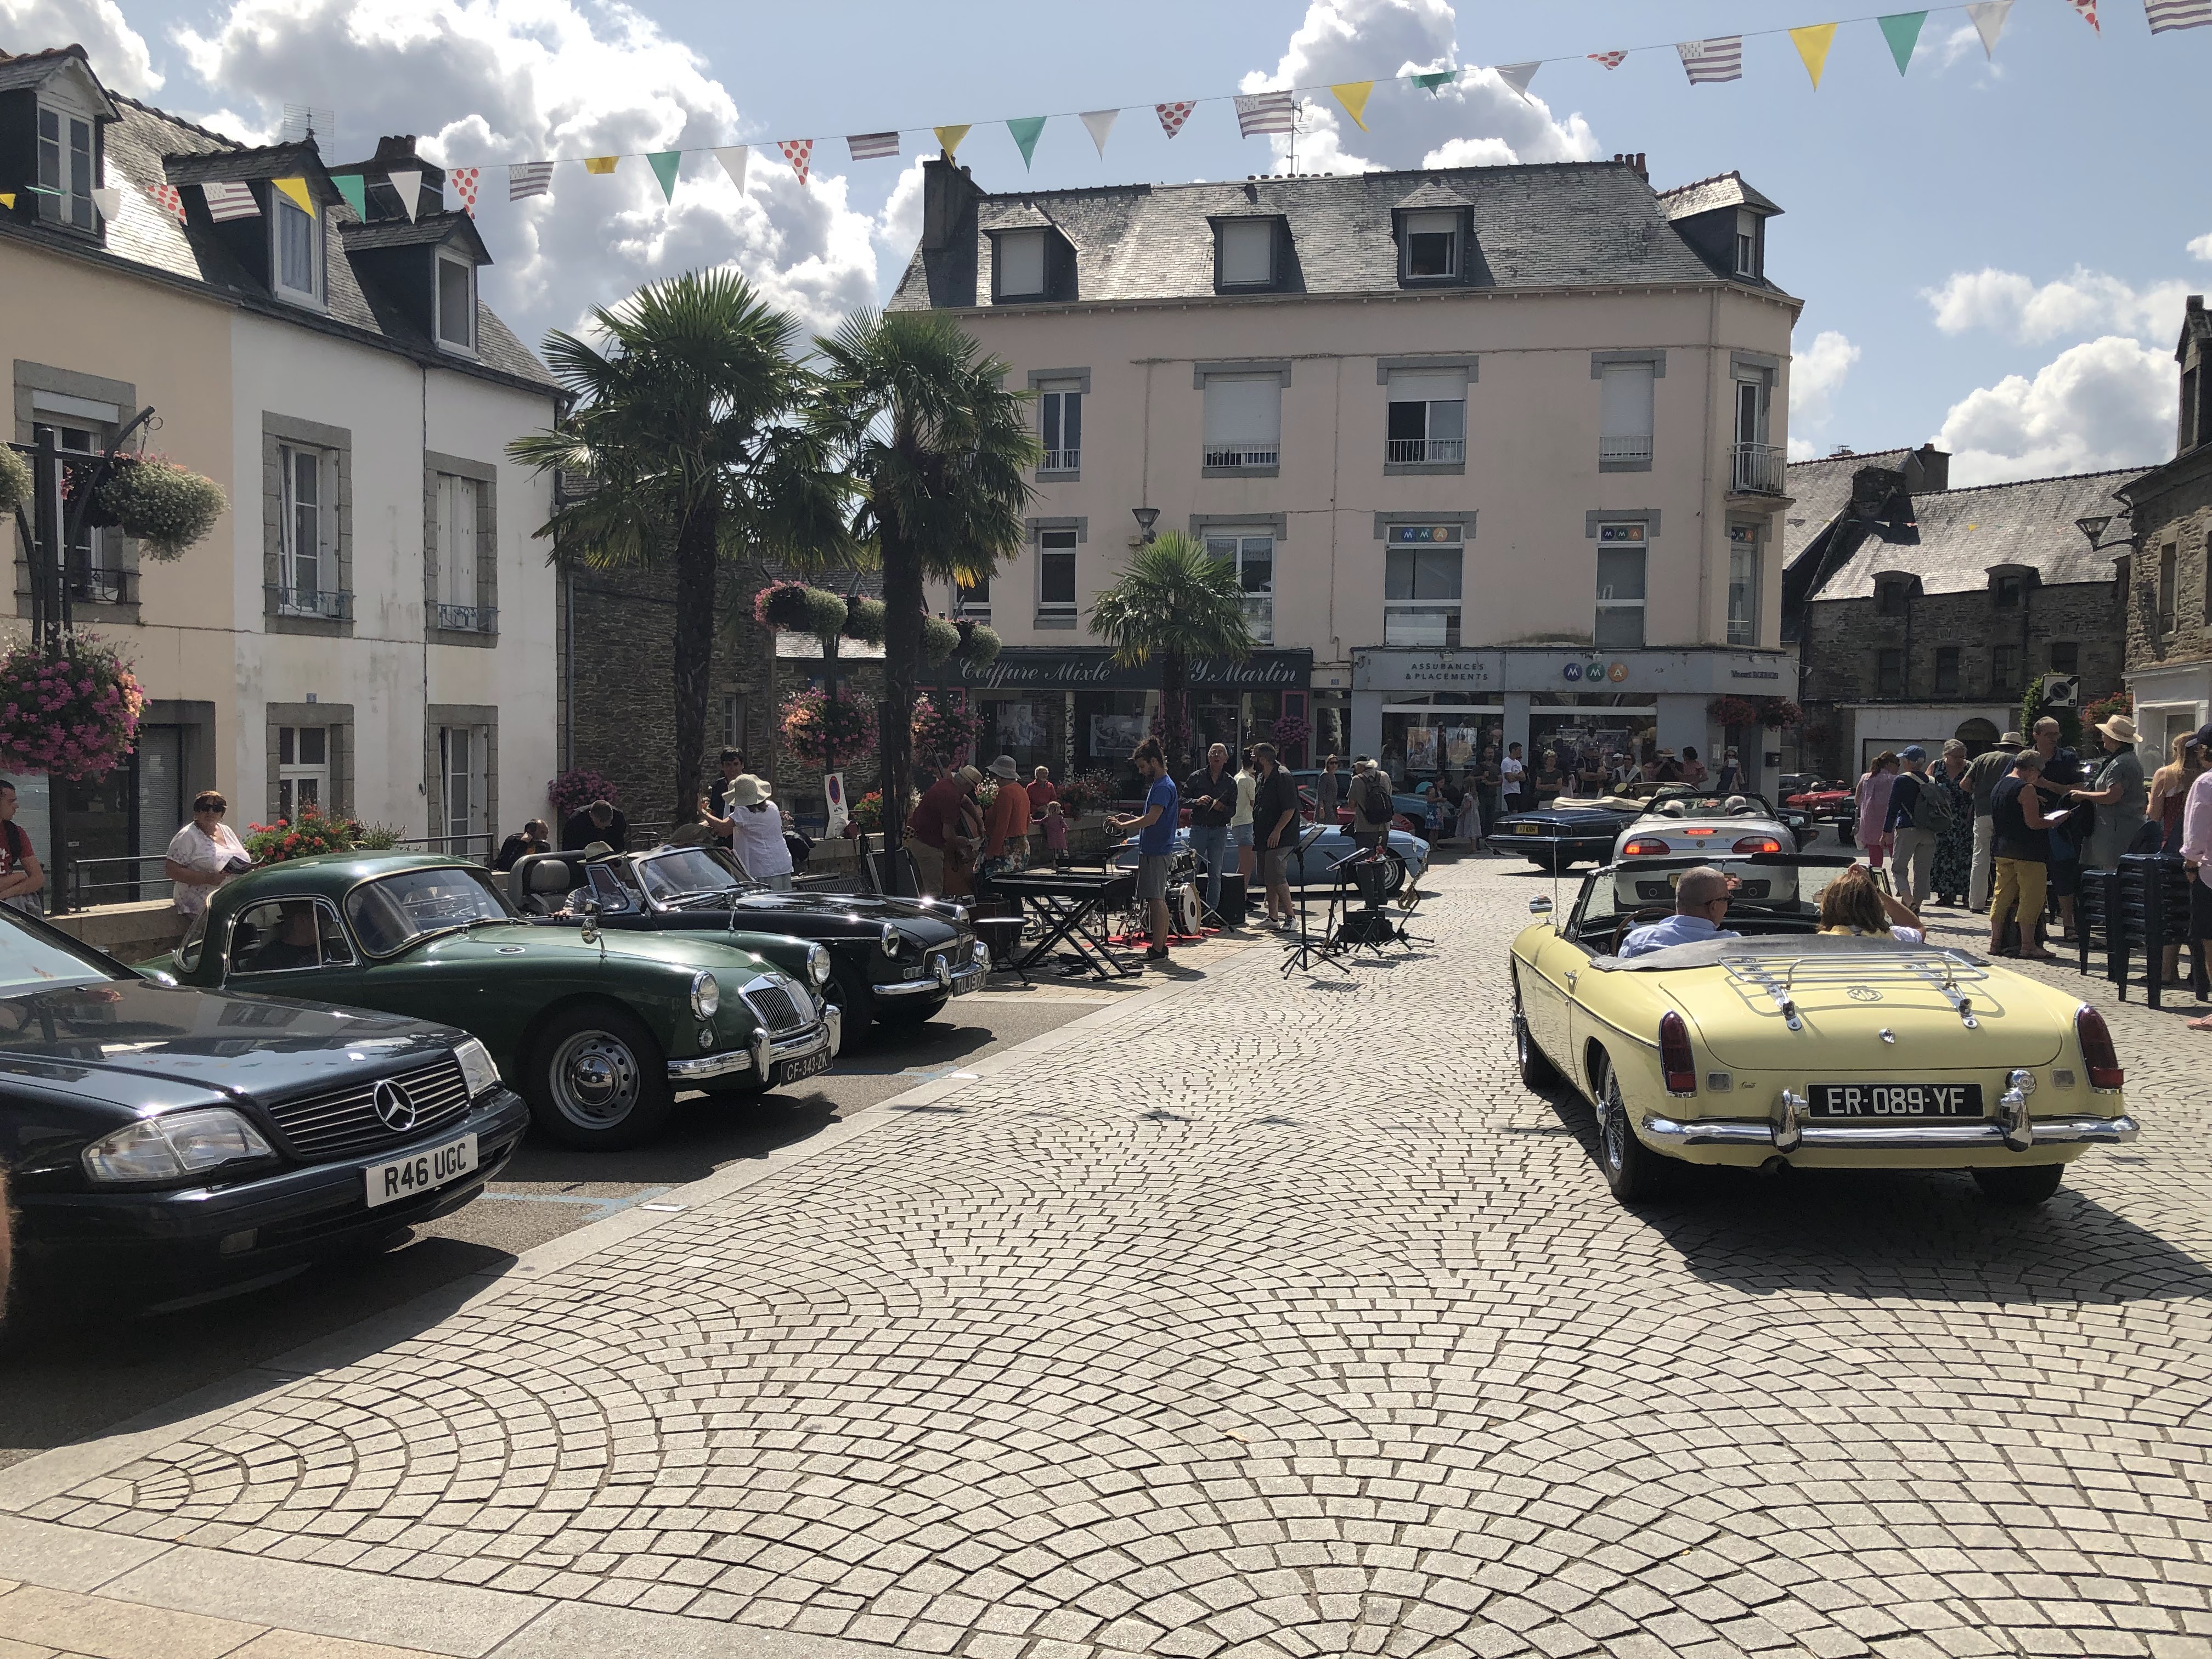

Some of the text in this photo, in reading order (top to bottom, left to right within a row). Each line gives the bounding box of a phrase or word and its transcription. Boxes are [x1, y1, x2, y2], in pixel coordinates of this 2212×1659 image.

[1402, 529, 1445, 540] MMA
[1604, 530, 1639, 538] MMA
[1566, 666, 1624, 679] MMA
[787, 1051, 827, 1081] CF-343-ZK
[1827, 1088, 1965, 1114] ER-089-YF
[385, 1142, 466, 1197] R46 UGC
